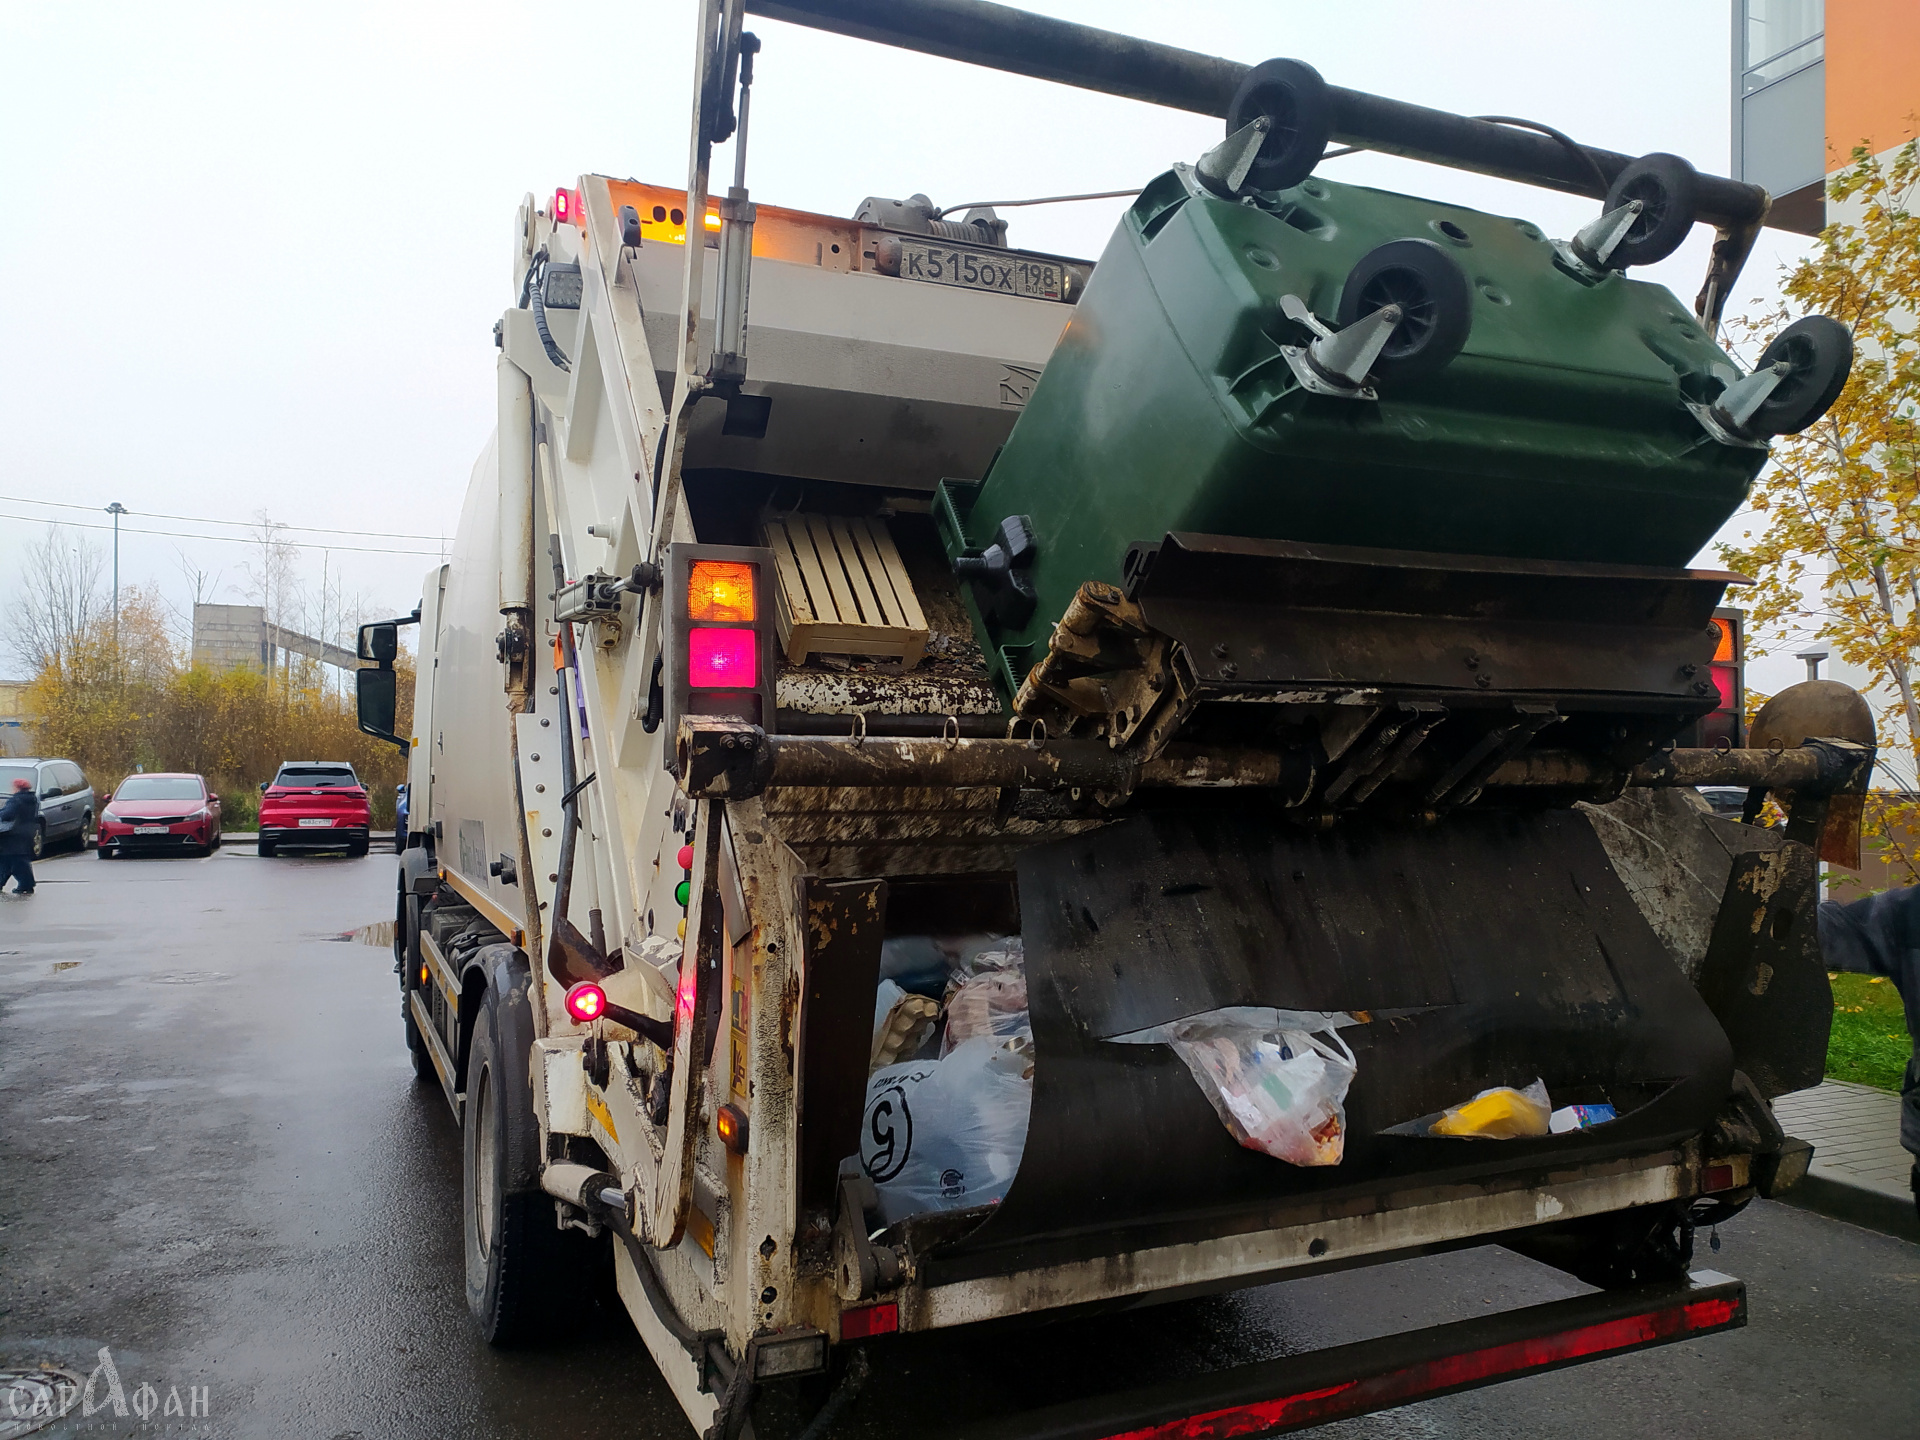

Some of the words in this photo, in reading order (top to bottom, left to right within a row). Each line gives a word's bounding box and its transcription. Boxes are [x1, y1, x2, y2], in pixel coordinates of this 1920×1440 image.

[908, 250, 1013, 290] К515ОХ
[1018, 263, 1055, 286] 198
[1025, 284, 1044, 295] RUS
